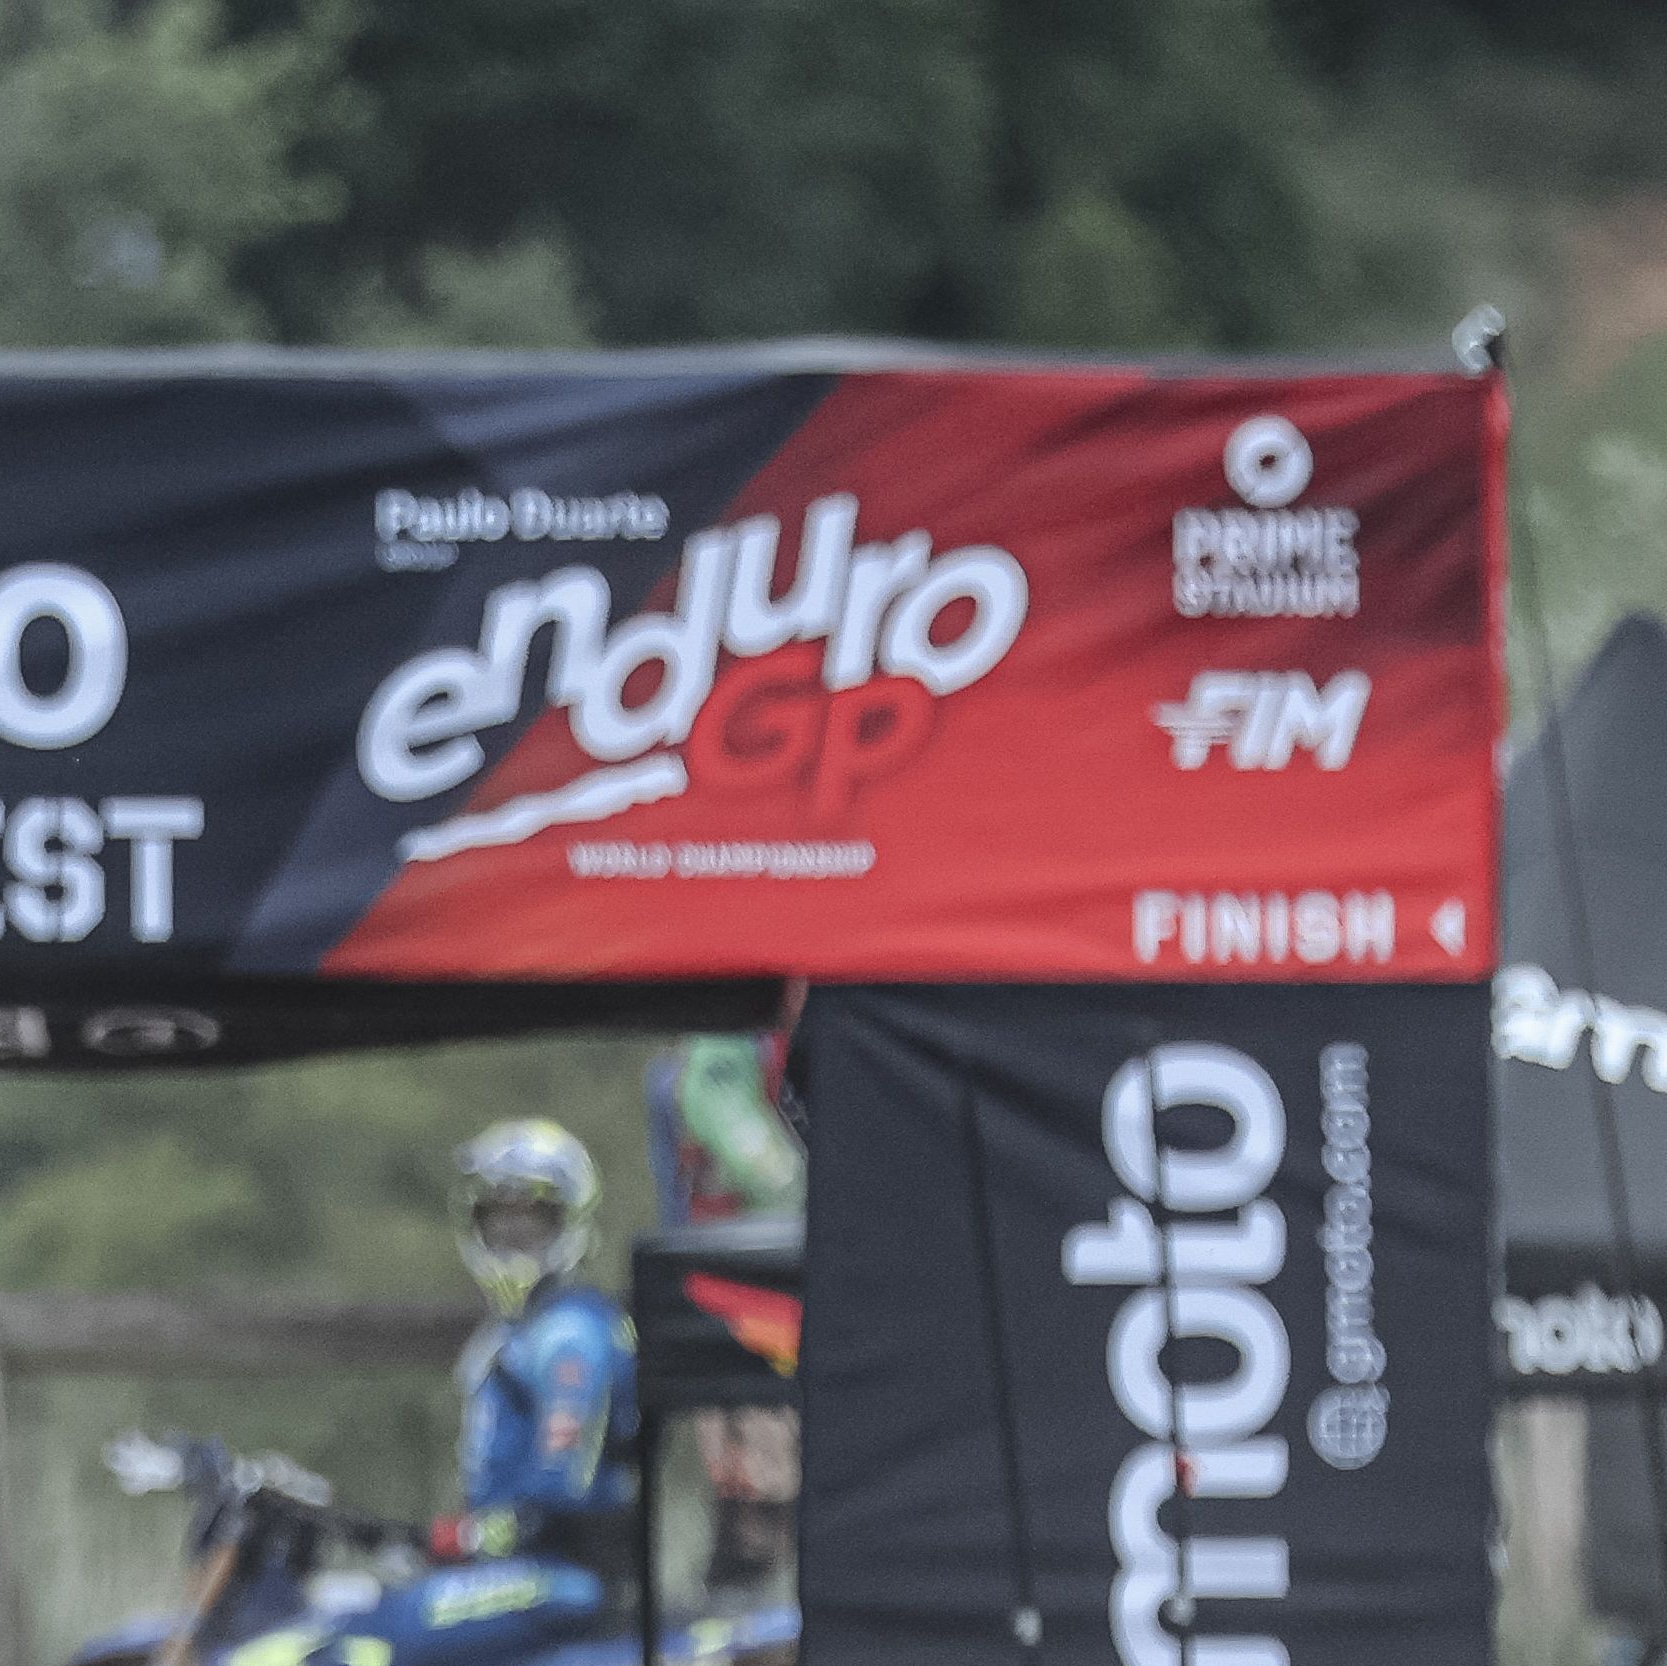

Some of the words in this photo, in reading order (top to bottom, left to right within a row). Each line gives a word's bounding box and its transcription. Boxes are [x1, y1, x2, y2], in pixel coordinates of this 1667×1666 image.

[357, 494, 1029, 802] enduro
[1151, 669, 1371, 772] FIM
[1132, 889, 1396, 964] FINISH
